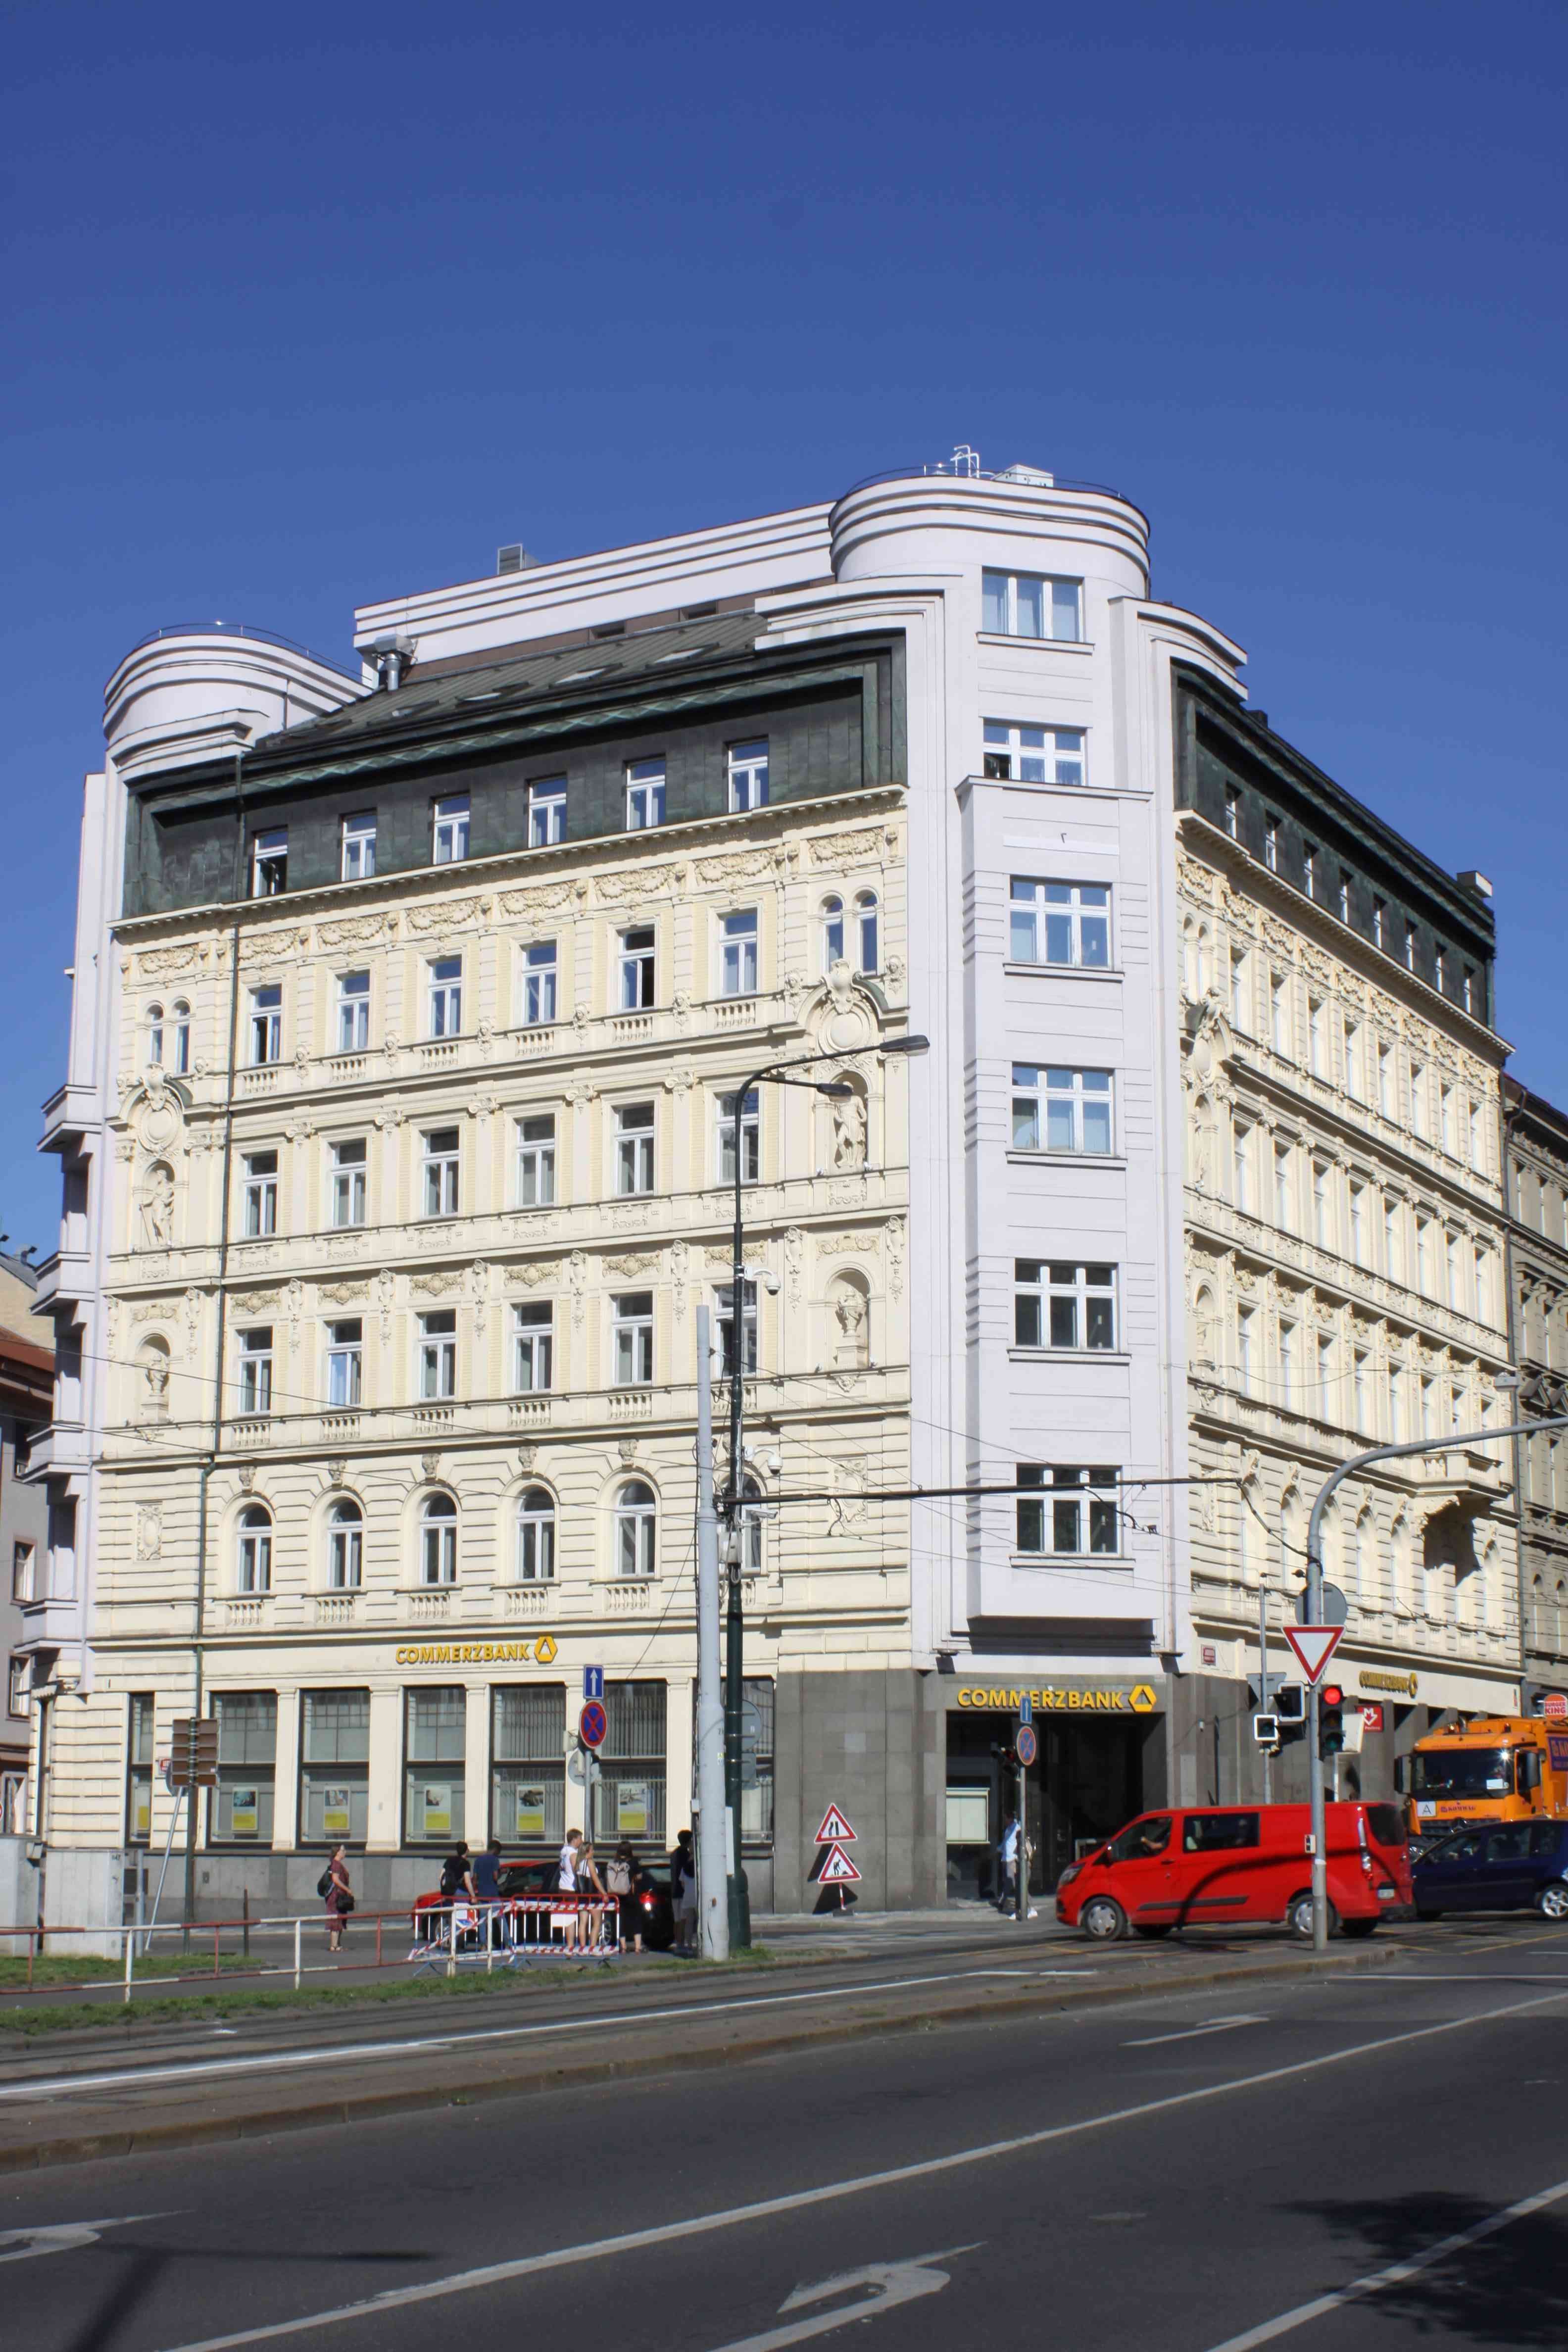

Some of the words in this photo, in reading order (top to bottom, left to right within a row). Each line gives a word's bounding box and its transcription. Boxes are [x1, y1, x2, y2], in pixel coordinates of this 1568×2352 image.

[396, 1644, 529, 1664] COMMERZBANK
[958, 1688, 1124, 1709] COMMERZBANK
[1422, 1804, 1431, 1814] A
